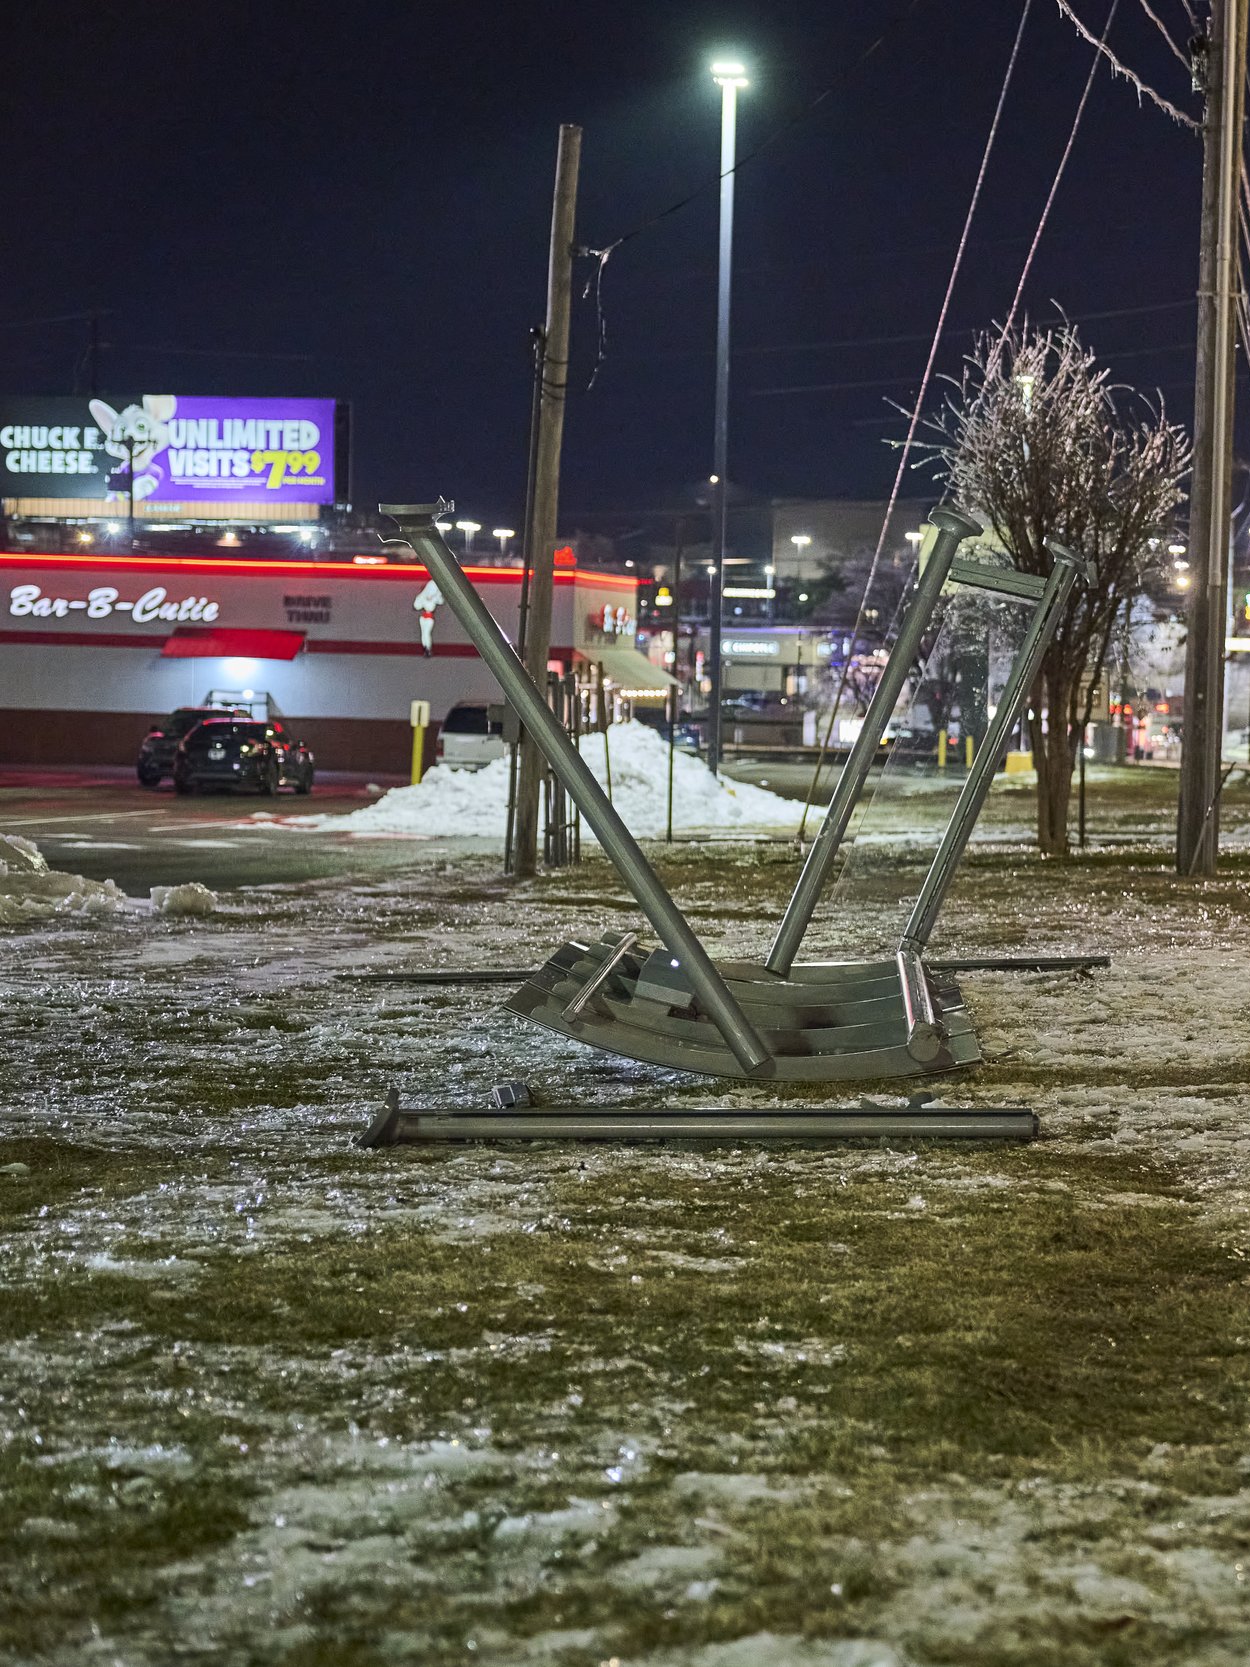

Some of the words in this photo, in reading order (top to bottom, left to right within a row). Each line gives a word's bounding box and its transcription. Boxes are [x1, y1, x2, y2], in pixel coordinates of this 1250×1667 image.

[0, 426, 81, 449] CHUCK
[168, 418, 320, 450] UNLIMITED
[168, 450, 250, 477] VISITS
[10, 584, 219, 623] Bar-B-Cutie
[283, 596, 332, 608] DRIVE
